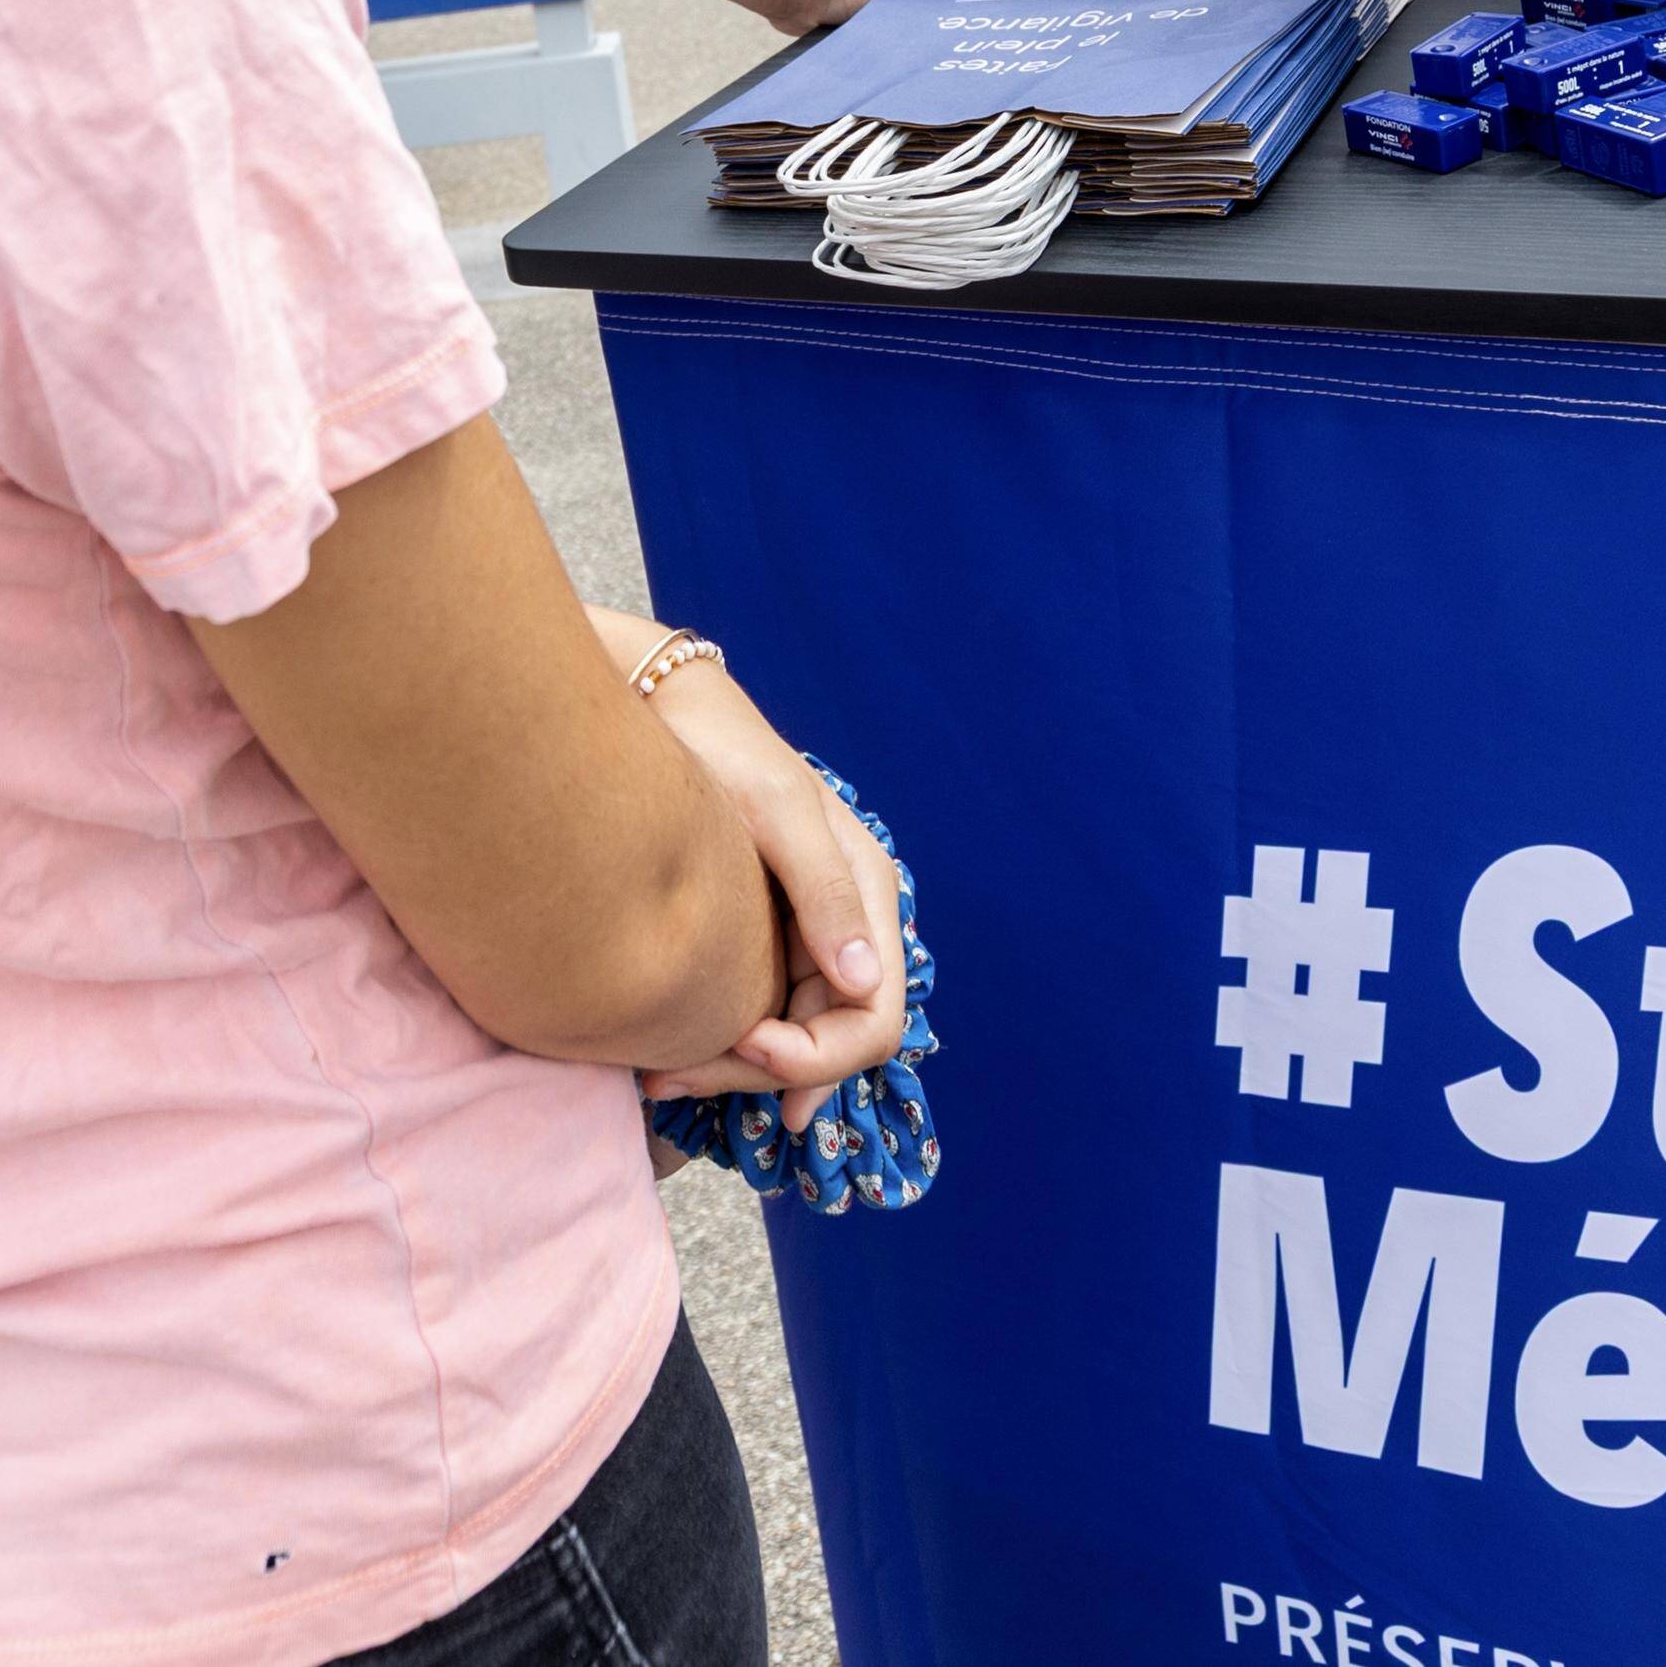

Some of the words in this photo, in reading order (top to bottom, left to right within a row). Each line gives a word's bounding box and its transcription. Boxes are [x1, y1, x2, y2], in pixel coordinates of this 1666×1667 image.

[937, 10, 1133, 33] vigilance.
[1149, 6, 1209, 21] de
[953, 34, 1073, 55] plein
[1079, 31, 1121, 48] le
[1368, 129, 1398, 142] VINCI
[1220, 1582, 1566, 1667] PRÉSE
